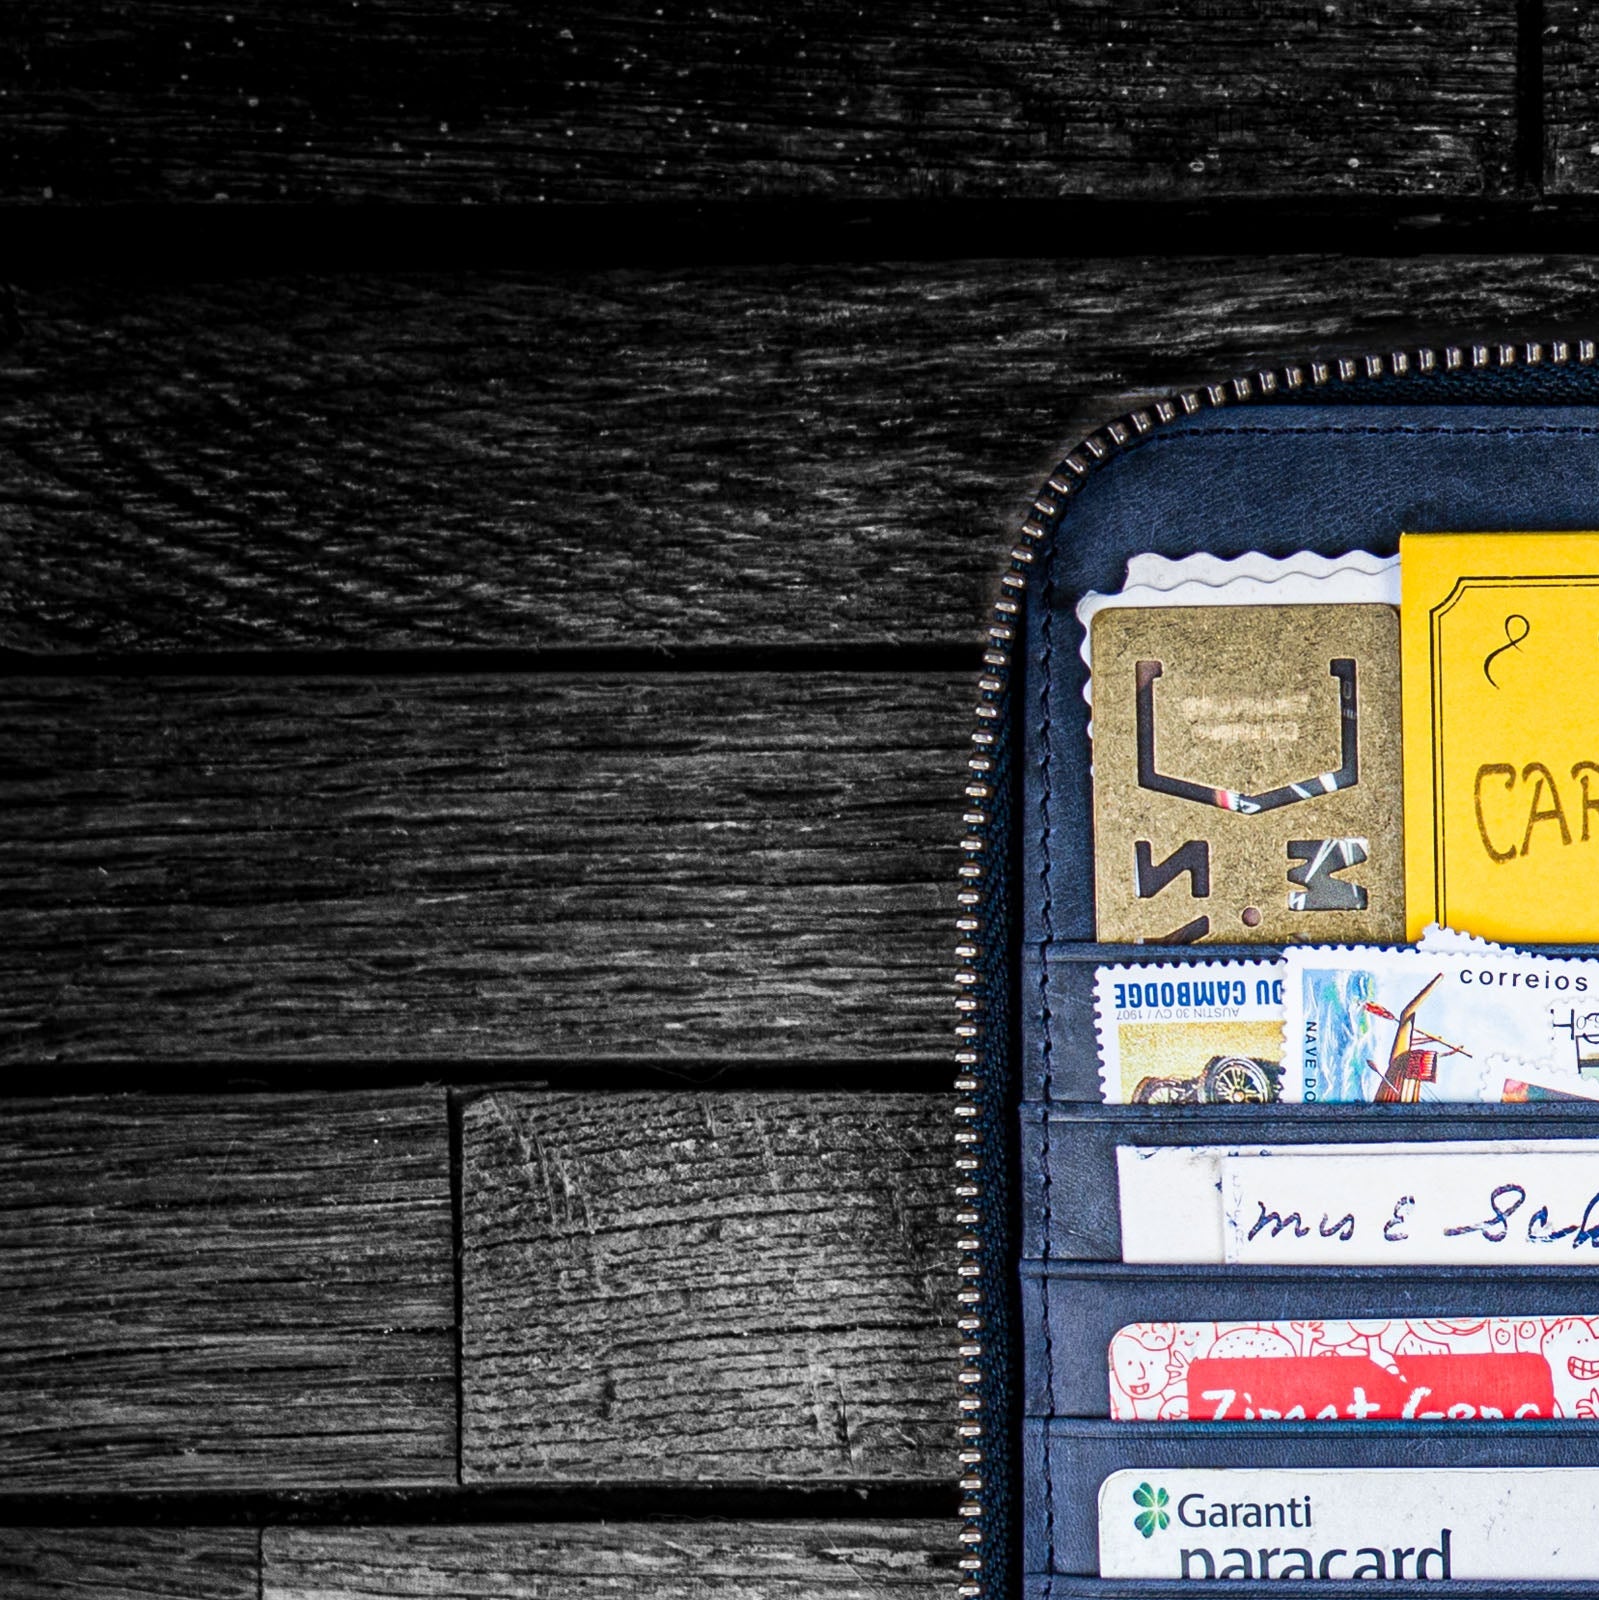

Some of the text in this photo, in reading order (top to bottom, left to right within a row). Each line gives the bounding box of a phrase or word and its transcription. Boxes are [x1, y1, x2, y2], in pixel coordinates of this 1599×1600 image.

[1459, 968, 1588, 992] correios
[1114, 980, 1247, 1009] CAMBODGE
[1116, 1008, 1143, 1021] 1907
[1154, 1008, 1173, 1020] CV
[1175, 1007, 1190, 1019] 30
[1194, 1006, 1240, 1019] AUSTIN
[1306, 1020, 1317, 1070] NAVE
[1176, 1492, 1313, 1528] Garanti
